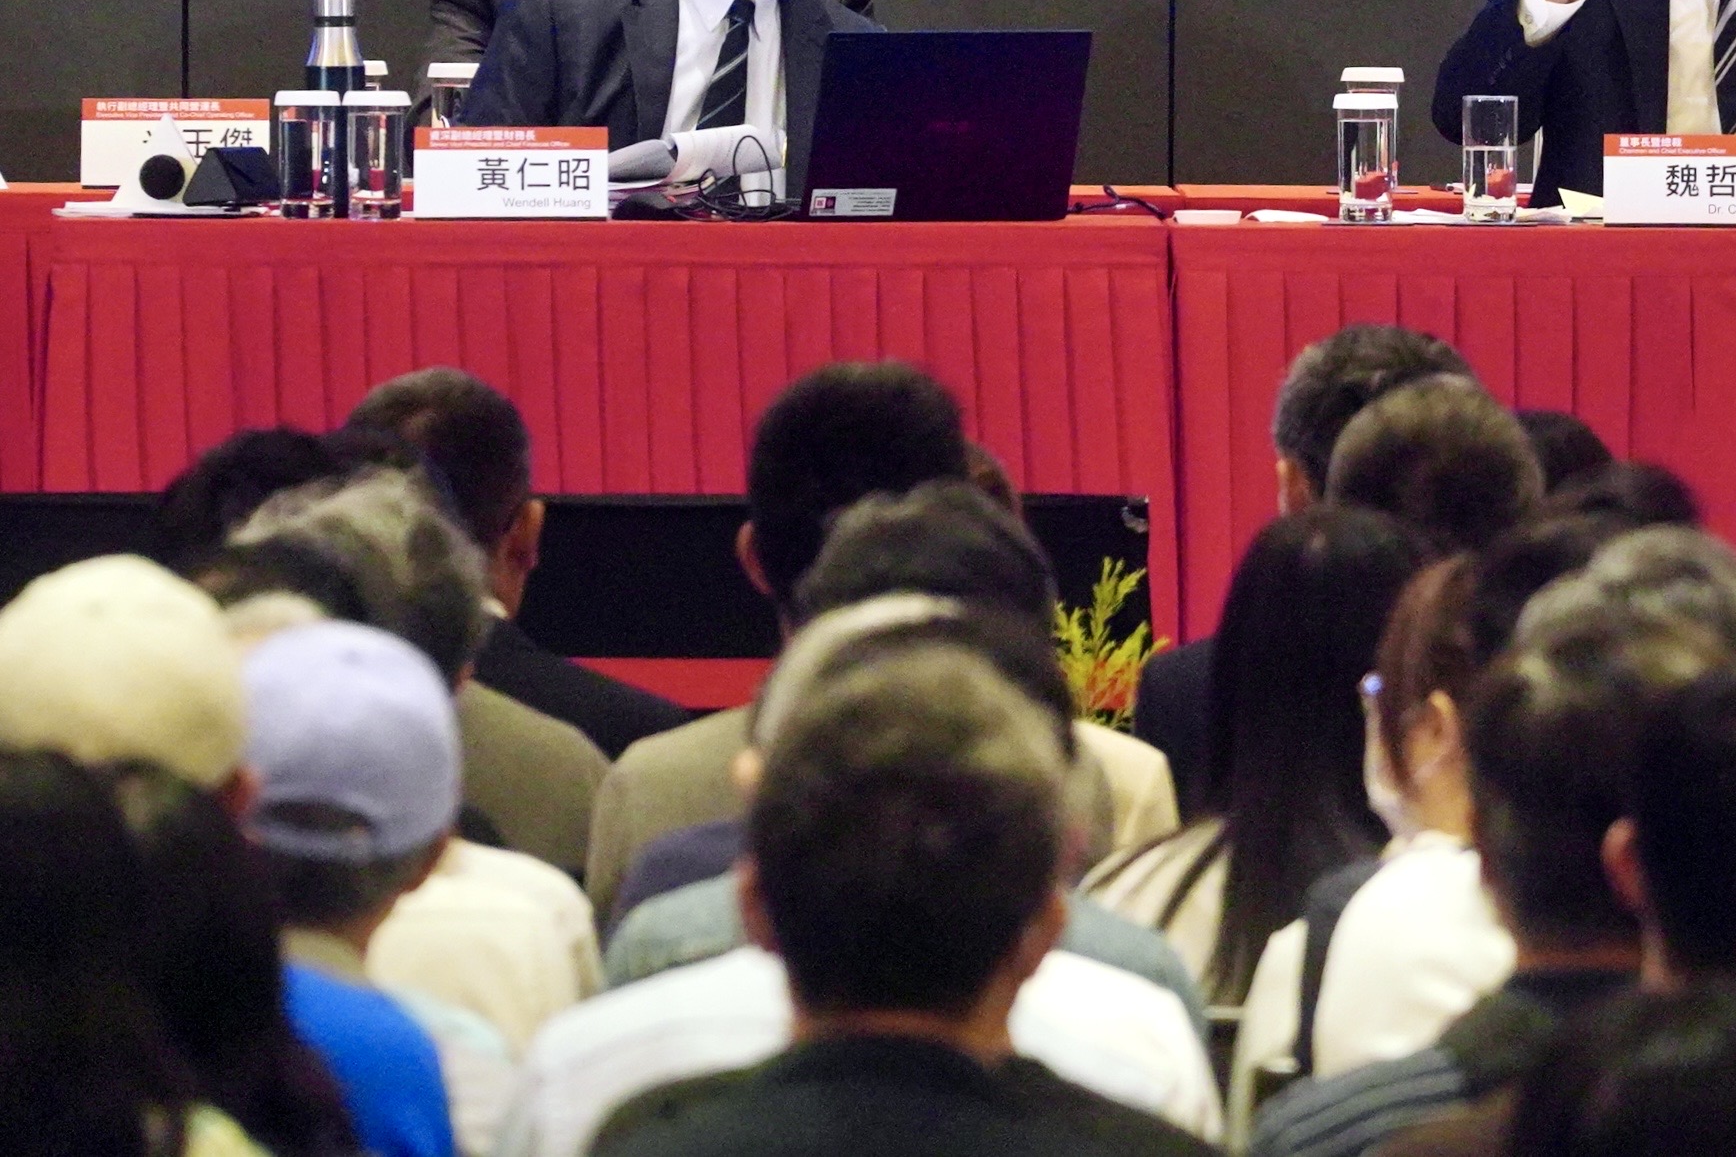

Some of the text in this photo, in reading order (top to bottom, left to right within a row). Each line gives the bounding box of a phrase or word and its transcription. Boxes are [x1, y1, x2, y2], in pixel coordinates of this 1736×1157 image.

[477, 158, 590, 191] 黃仁昭
[503, 198, 591, 209] Wendell Huang
[1708, 204, 1723, 214] Dr.
